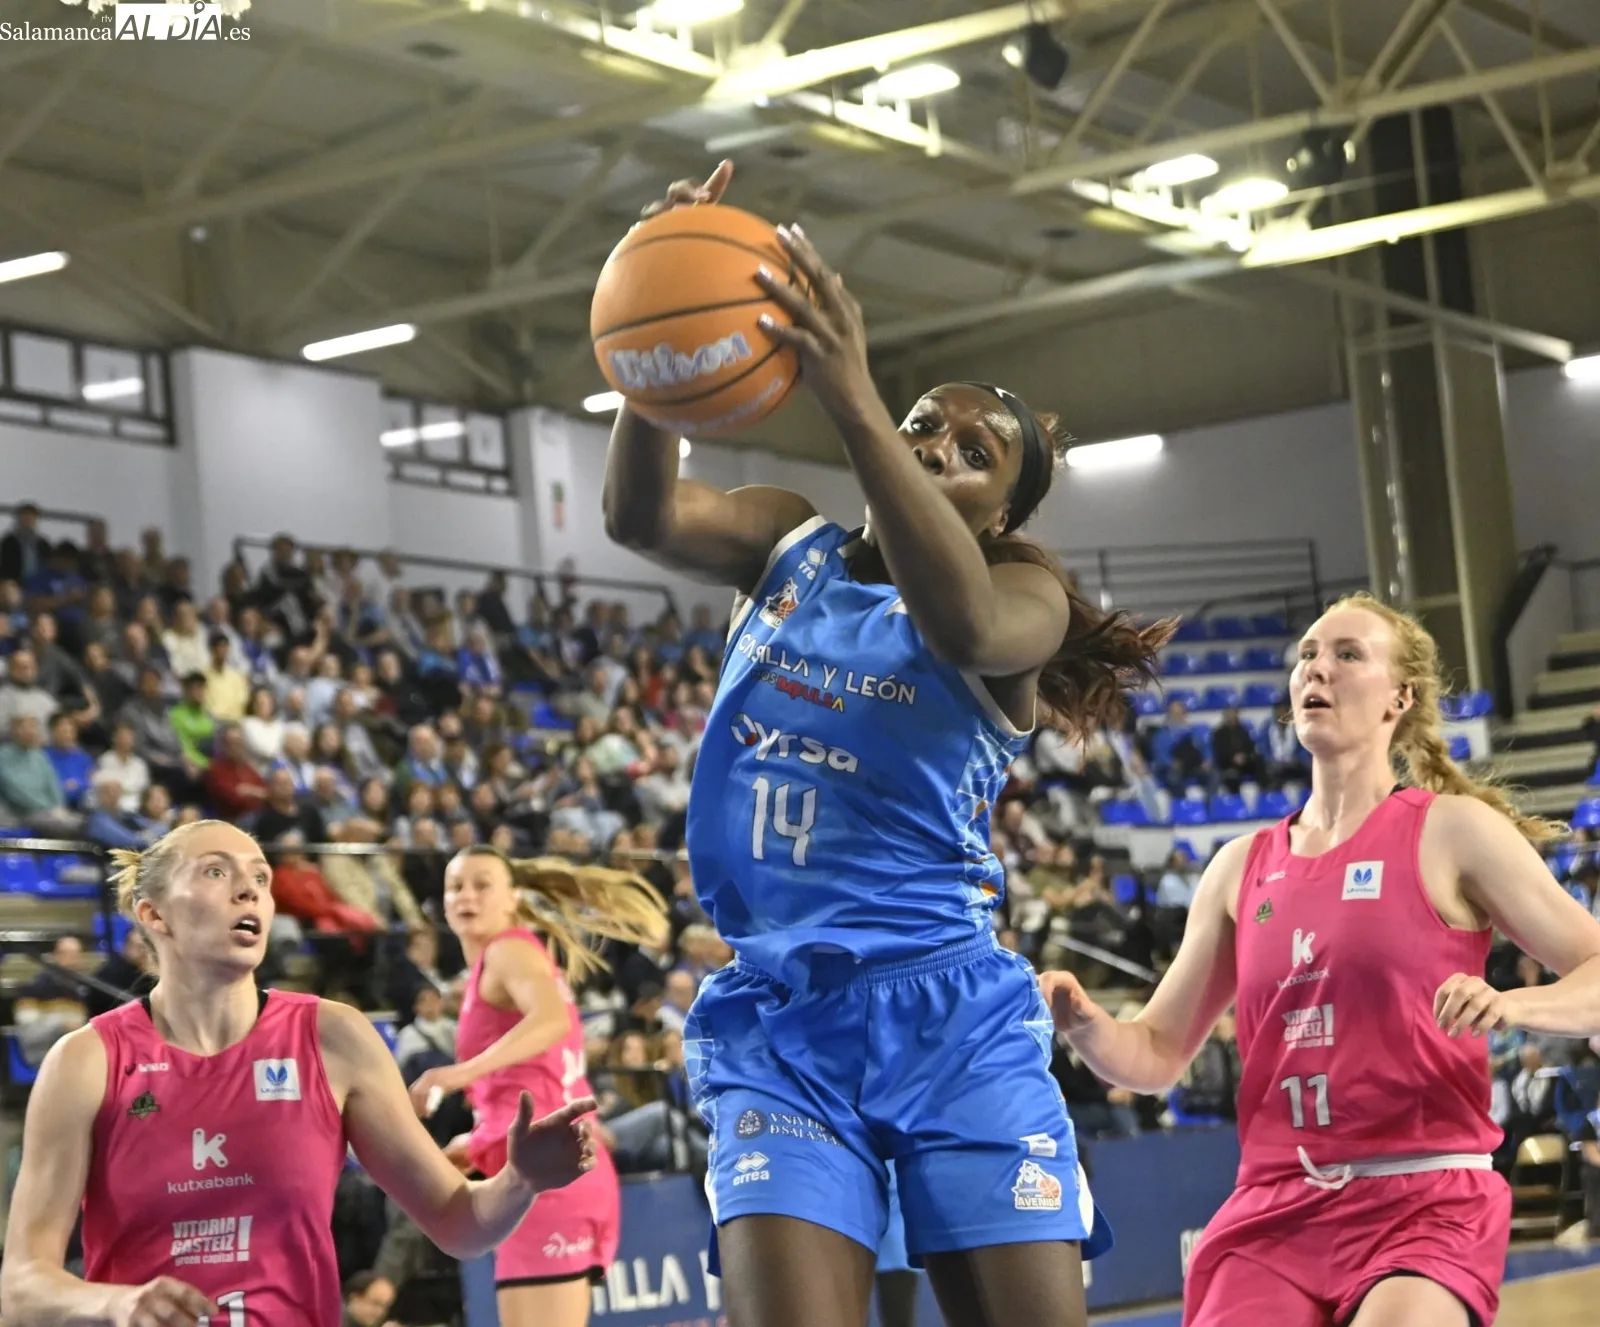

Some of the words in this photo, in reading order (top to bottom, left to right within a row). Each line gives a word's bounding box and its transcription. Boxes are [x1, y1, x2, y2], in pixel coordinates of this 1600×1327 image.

[823, 664, 838, 690] Y
[845, 672, 916, 705] LEÓN
[752, 776, 817, 867] 14
[1280, 1073, 1332, 1128] 11
[167, 1173, 254, 1194] kutxabank
[172, 1216, 236, 1239] VITORIA
[170, 1233, 236, 1256] GASTEIZ
